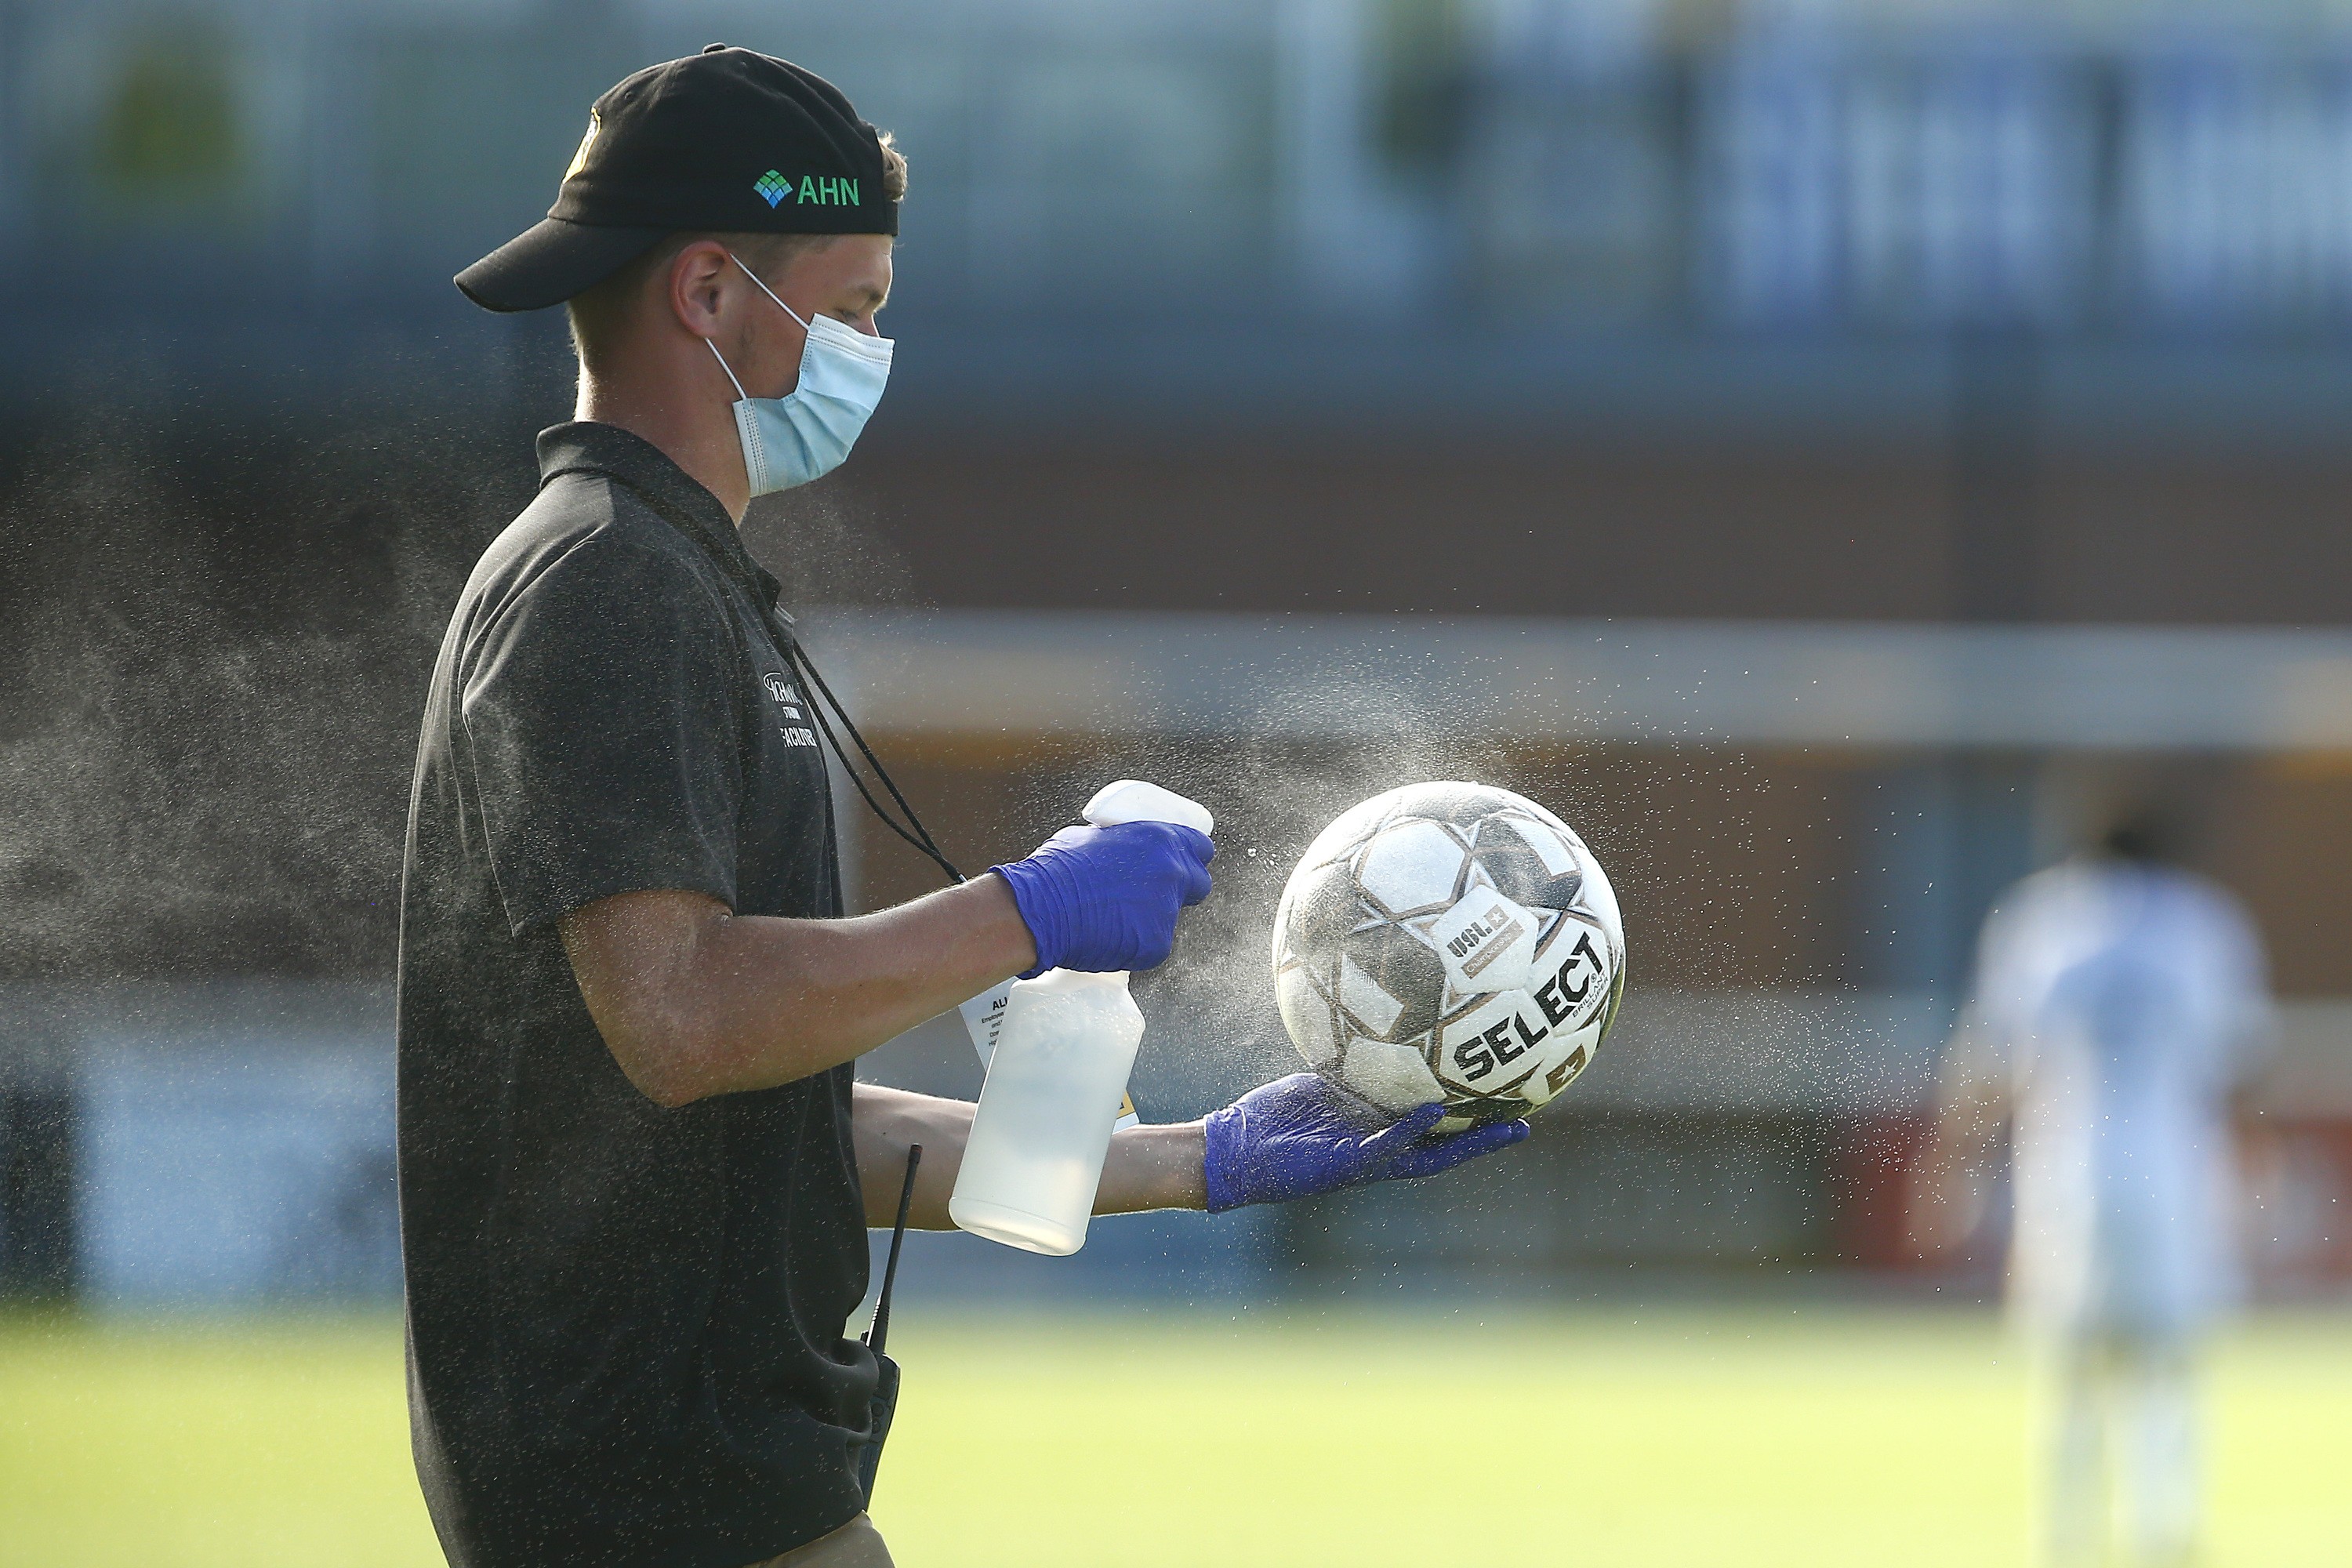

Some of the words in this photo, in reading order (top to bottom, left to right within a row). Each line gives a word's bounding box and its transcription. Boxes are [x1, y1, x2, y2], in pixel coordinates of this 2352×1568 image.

[797, 175, 861, 206] AHN
[1446, 921, 1493, 958] USL
[1465, 932, 1513, 973] Championship
[1453, 931, 1603, 1083] SELECT
[1572, 969, 1606, 1018] BRILLANT
[1586, 976, 1609, 1010] SUPER
